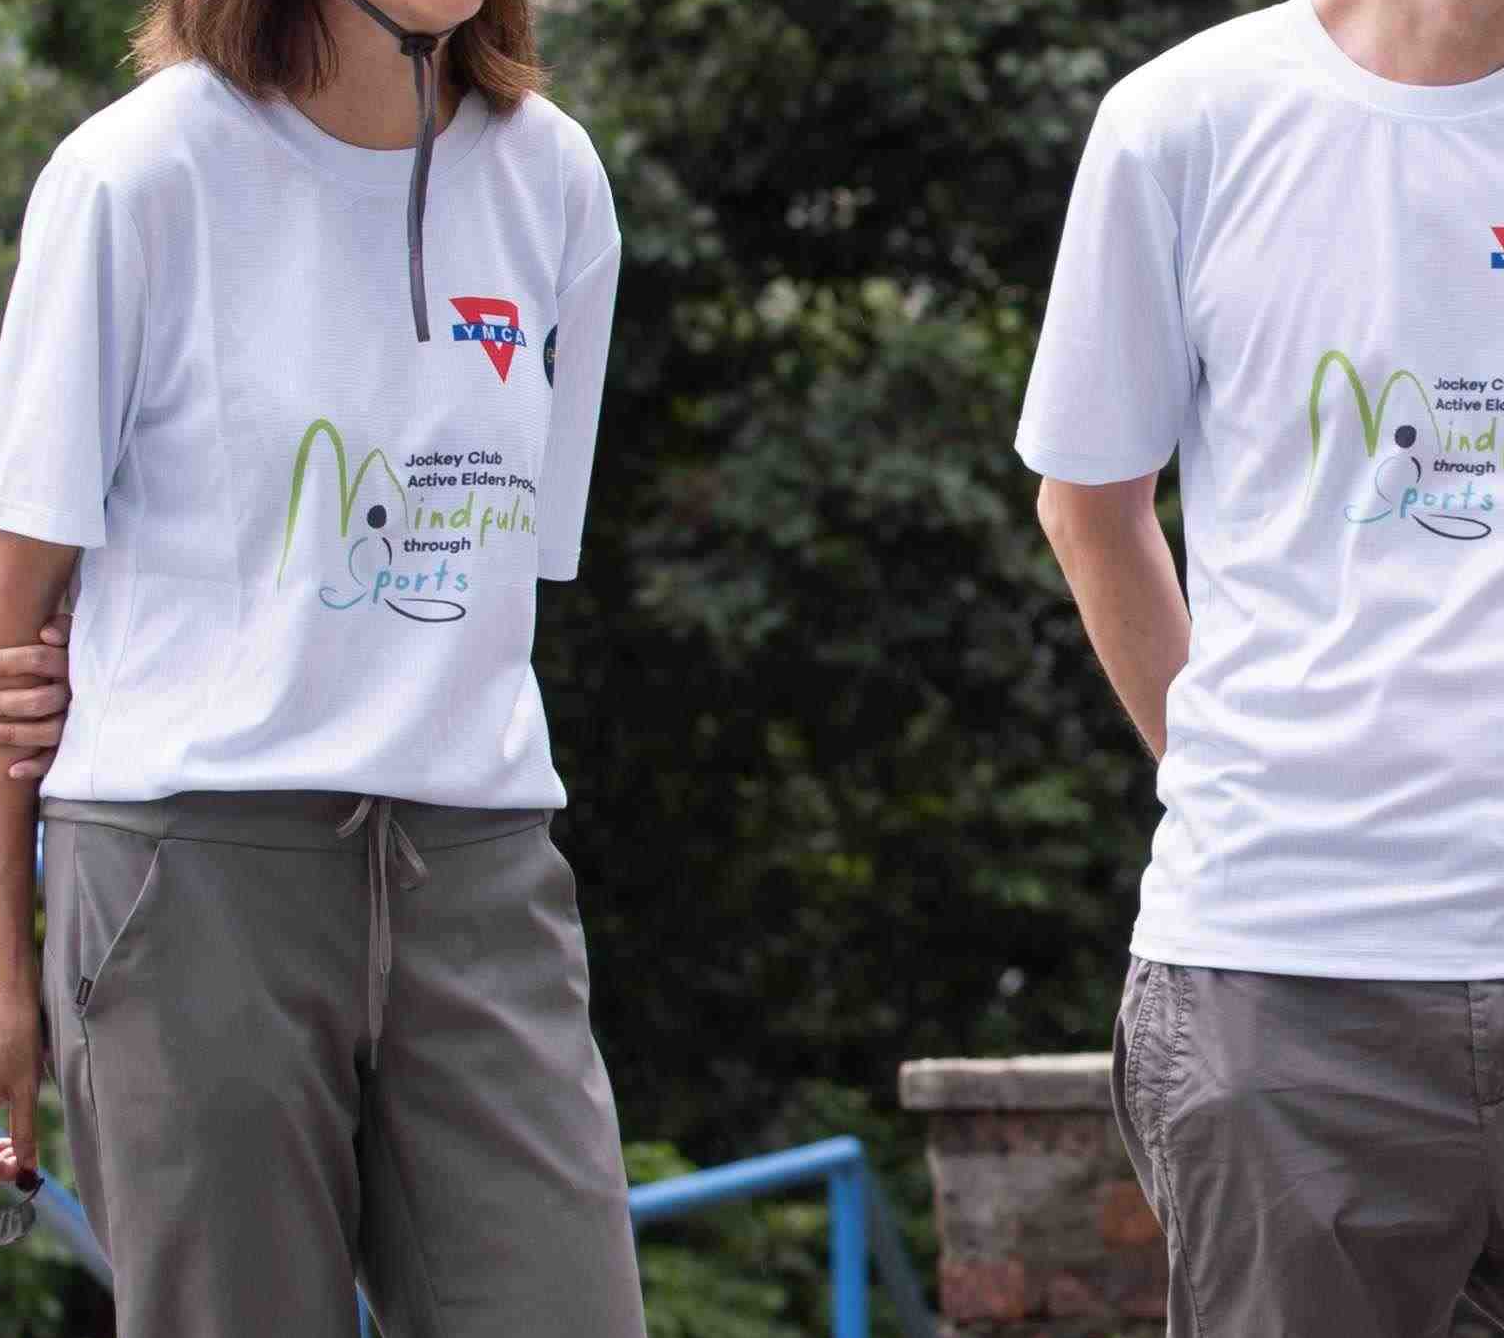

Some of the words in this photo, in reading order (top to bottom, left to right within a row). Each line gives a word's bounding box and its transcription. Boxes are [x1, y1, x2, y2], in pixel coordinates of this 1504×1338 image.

[462, 324, 525, 345] YMCA
[1433, 377, 1488, 394] Jockey
[1434, 397, 1482, 412] Active
[405, 451, 464, 468] Jockey
[468, 450, 503, 466] Club
[1432, 458, 1496, 477] through
[407, 472, 458, 488] Active
[461, 471, 506, 487] Elders
[403, 536, 472, 554] through
